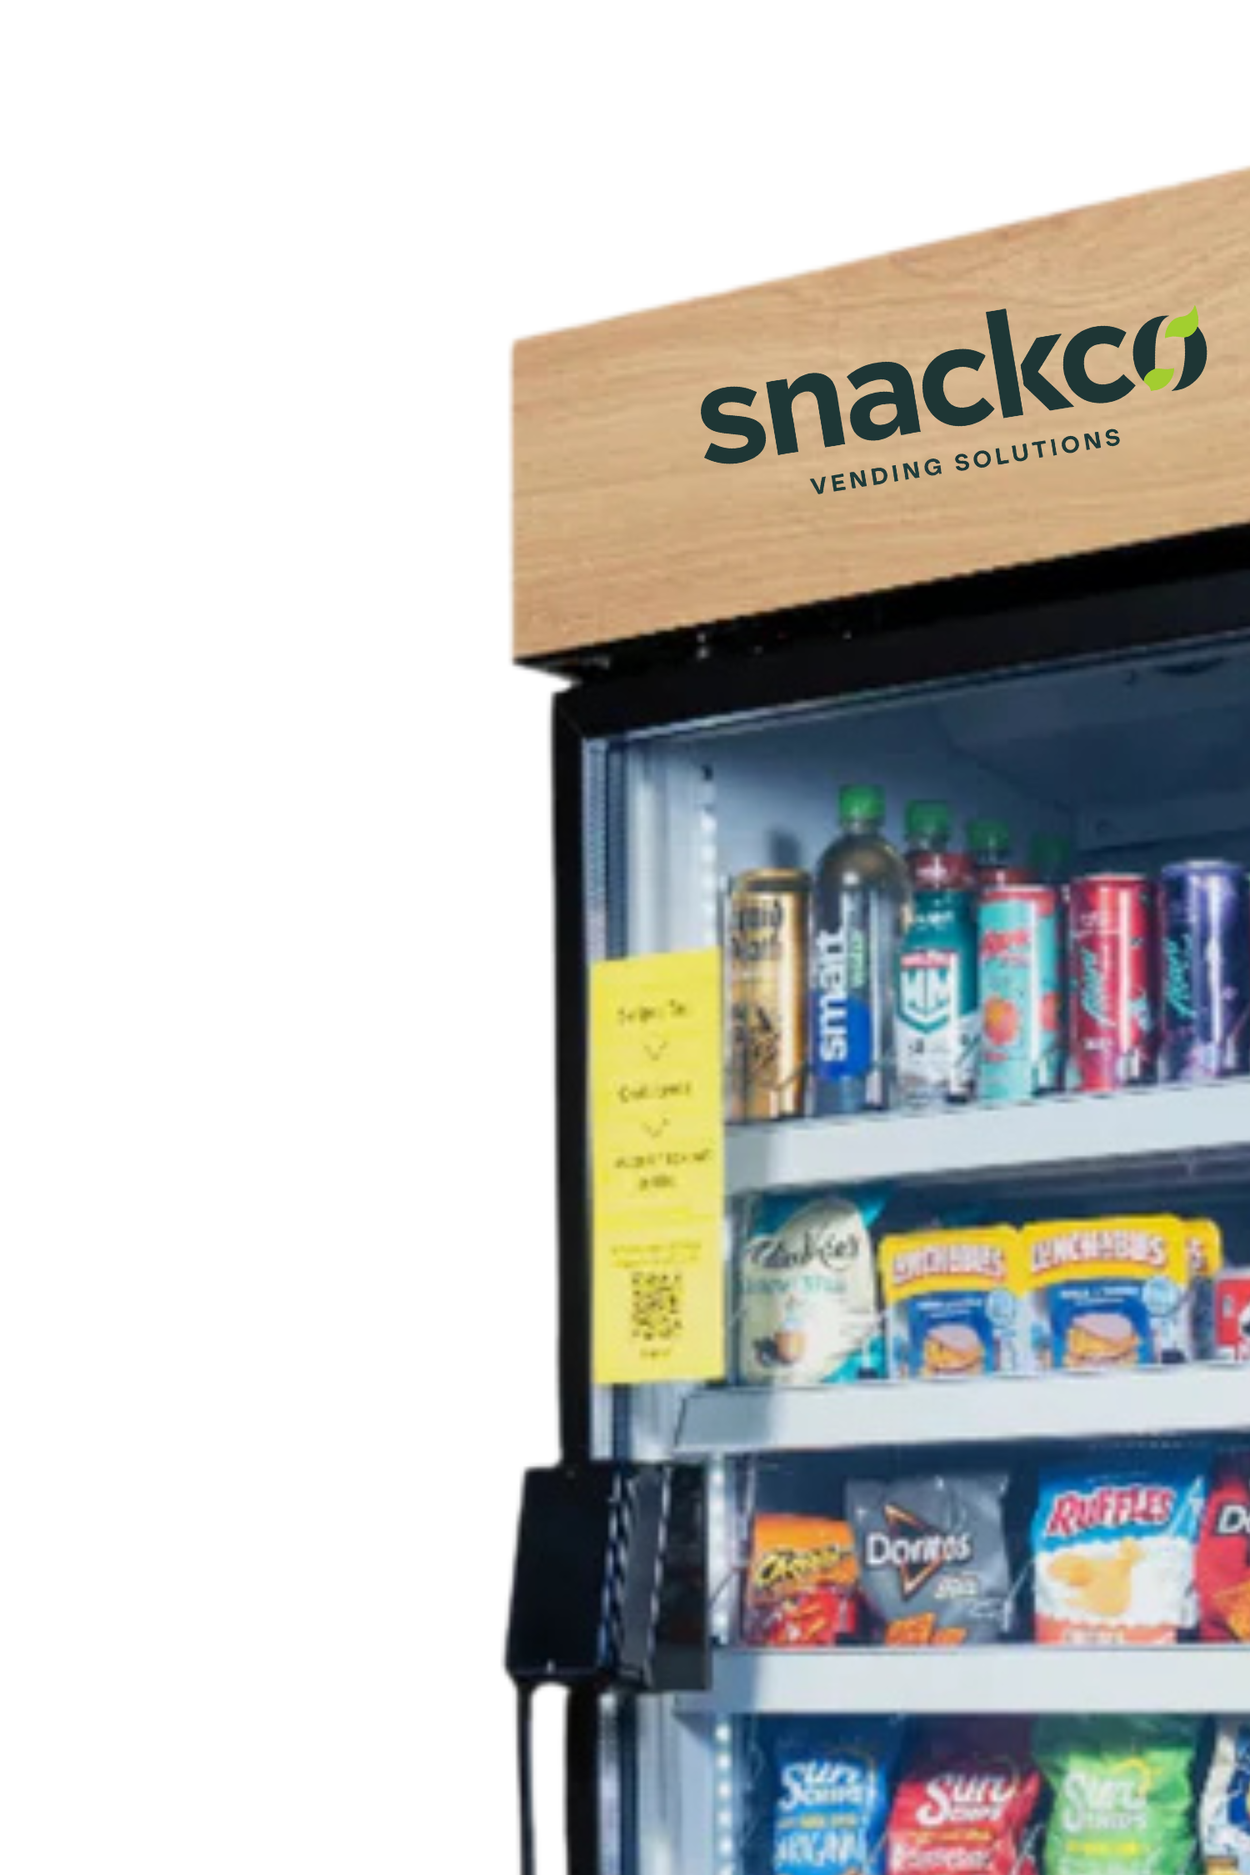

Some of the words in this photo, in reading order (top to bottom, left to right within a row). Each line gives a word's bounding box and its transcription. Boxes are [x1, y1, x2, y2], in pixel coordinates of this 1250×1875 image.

[701, 306, 1208, 465] snackco
[810, 457, 943, 495] VENDING
[954, 428, 1121, 472] SOLUTIONS
[816, 926, 849, 1064] smart
[1045, 1484, 1176, 1538] RUFFLES
[865, 1530, 974, 1567] Doritos
